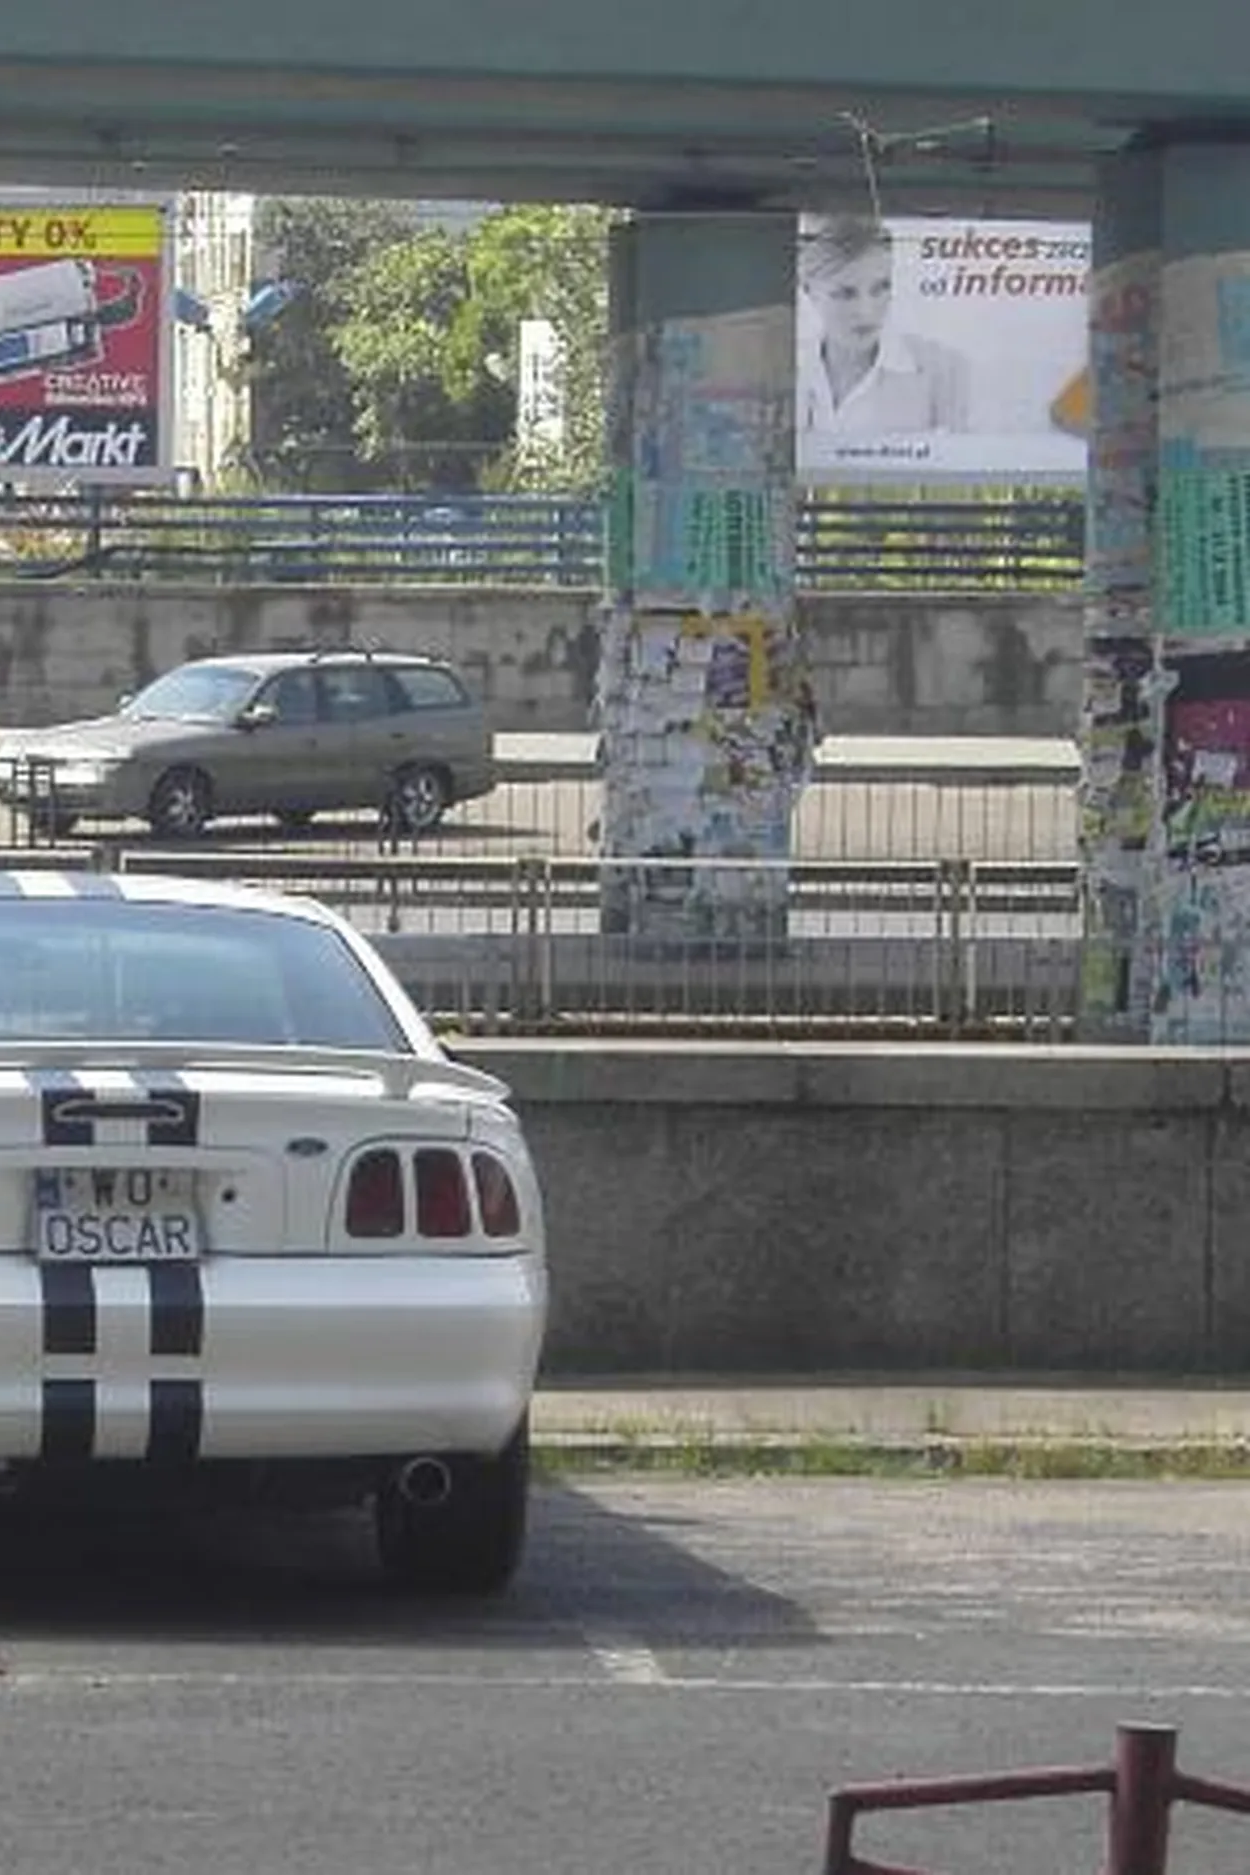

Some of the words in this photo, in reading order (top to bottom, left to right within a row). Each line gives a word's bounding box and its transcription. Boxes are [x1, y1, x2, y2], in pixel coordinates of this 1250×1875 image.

[44, 219, 98, 250] 0%
[920, 226, 1040, 260] sukces
[0, 414, 148, 465] Markt
[45, 1213, 191, 1256] OSCAR
